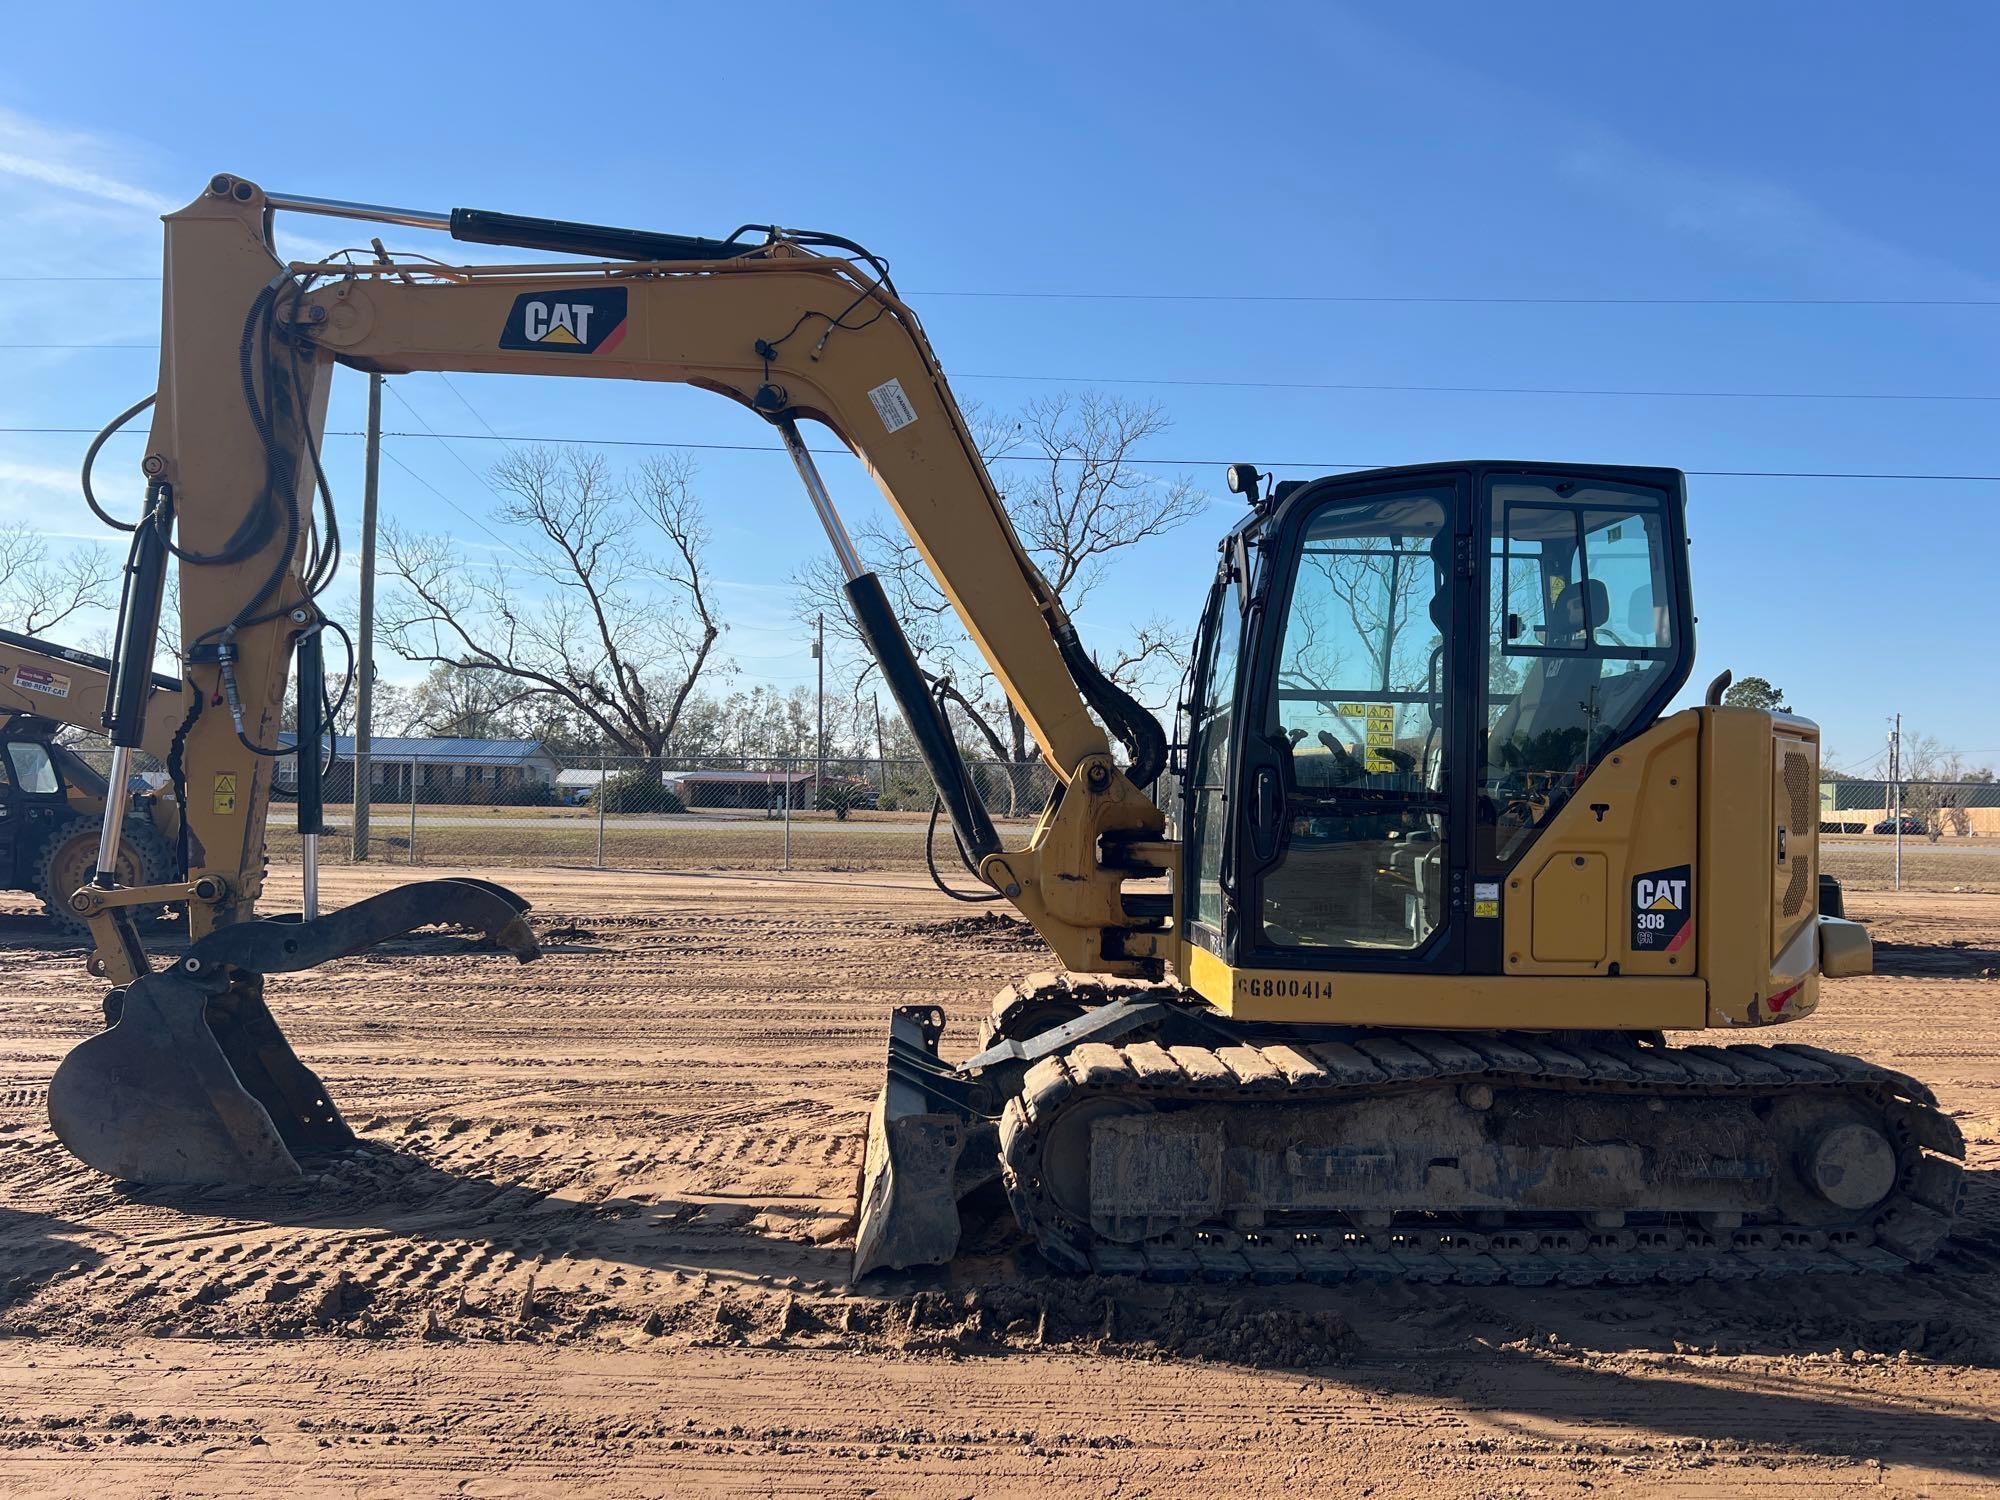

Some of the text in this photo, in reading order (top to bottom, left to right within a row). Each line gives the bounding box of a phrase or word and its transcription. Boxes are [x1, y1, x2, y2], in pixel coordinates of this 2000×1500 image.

[525, 301, 594, 345] CAT
[896, 394, 913, 421] WARNING
[16, 680, 66, 697] 1-800-RENT-CAT
[1637, 879, 1687, 910] CAT
[1637, 913, 1665, 930] 308
[1637, 931, 1653, 944] CR
